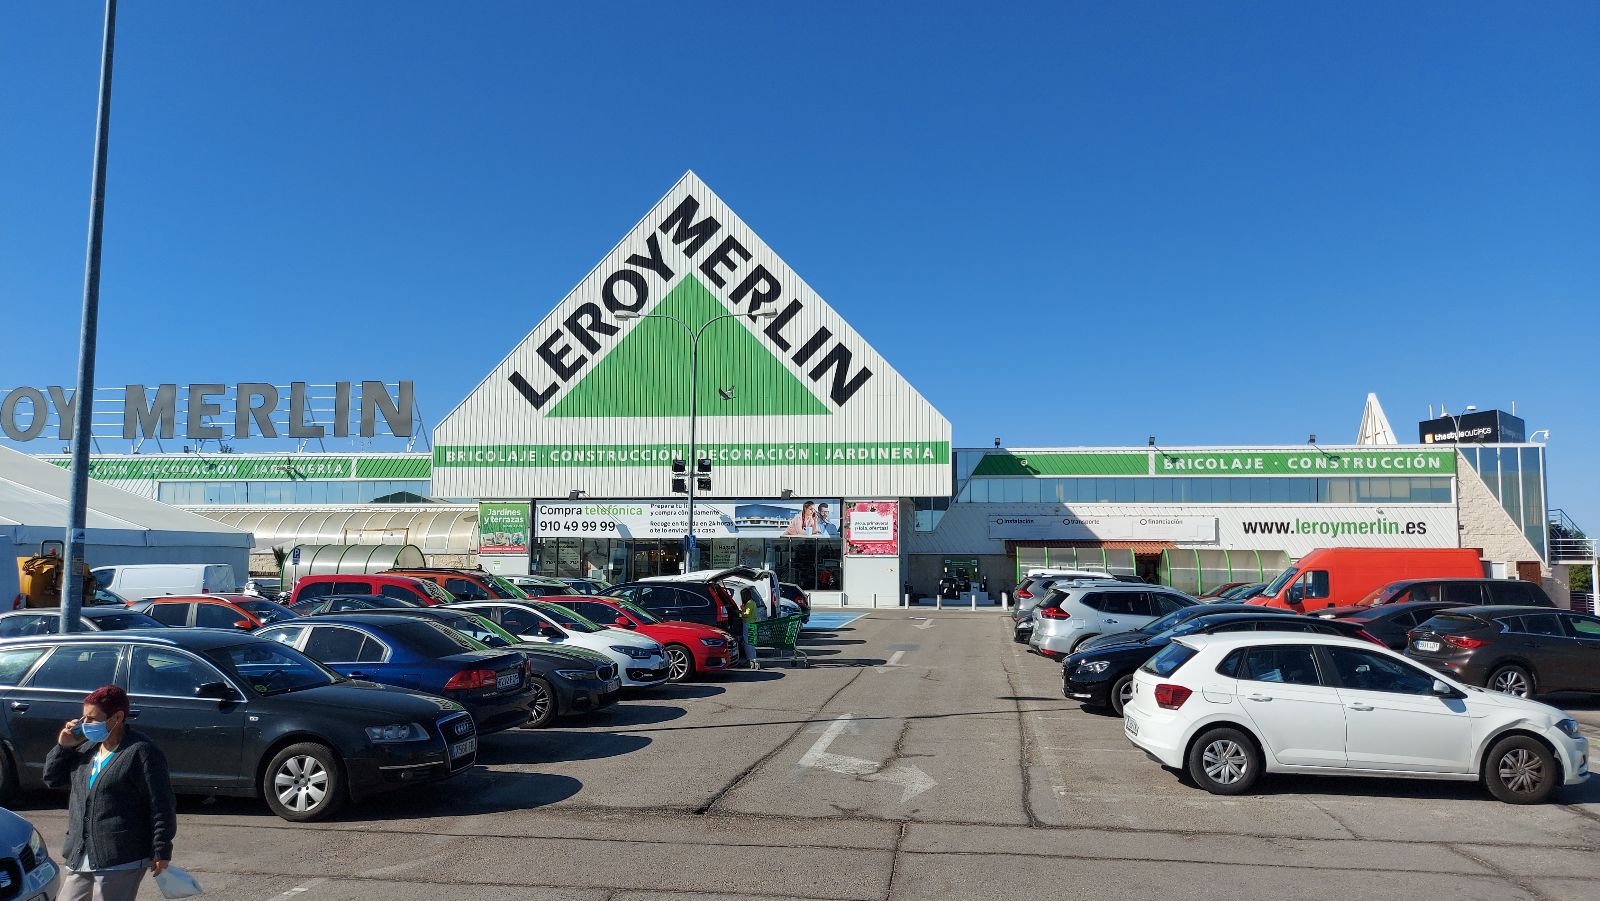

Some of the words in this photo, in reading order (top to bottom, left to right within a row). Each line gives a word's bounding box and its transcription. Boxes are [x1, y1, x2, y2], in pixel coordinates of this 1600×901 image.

[658, 194, 873, 407] MERLIN
[508, 231, 675, 411] LEROY
[122, 380, 414, 440] MERLIN
[445, 450, 536, 462] BRICOLAJE
[550, 446, 683, 462] CONSTRUCCIÓN
[696, 446, 809, 461] DECORACIÓN
[824, 444, 935, 460] JARDINERÍA
[1163, 458, 1264, 469] BRICOLAJE
[1287, 453, 1441, 469] CONSTRUCCIÓN
[484, 516, 490, 524] y
[490, 515, 524, 523] terrazas
[487, 507, 522, 516] Jardines
[540, 505, 582, 517] Compra
[584, 505, 643, 516] telefónica
[540, 521, 560, 531] 910
[563, 521, 579, 531] 49
[581, 521, 597, 531] 99
[600, 521, 616, 531] 99
[1242, 518, 1427, 538] www.leroymerlin.es
